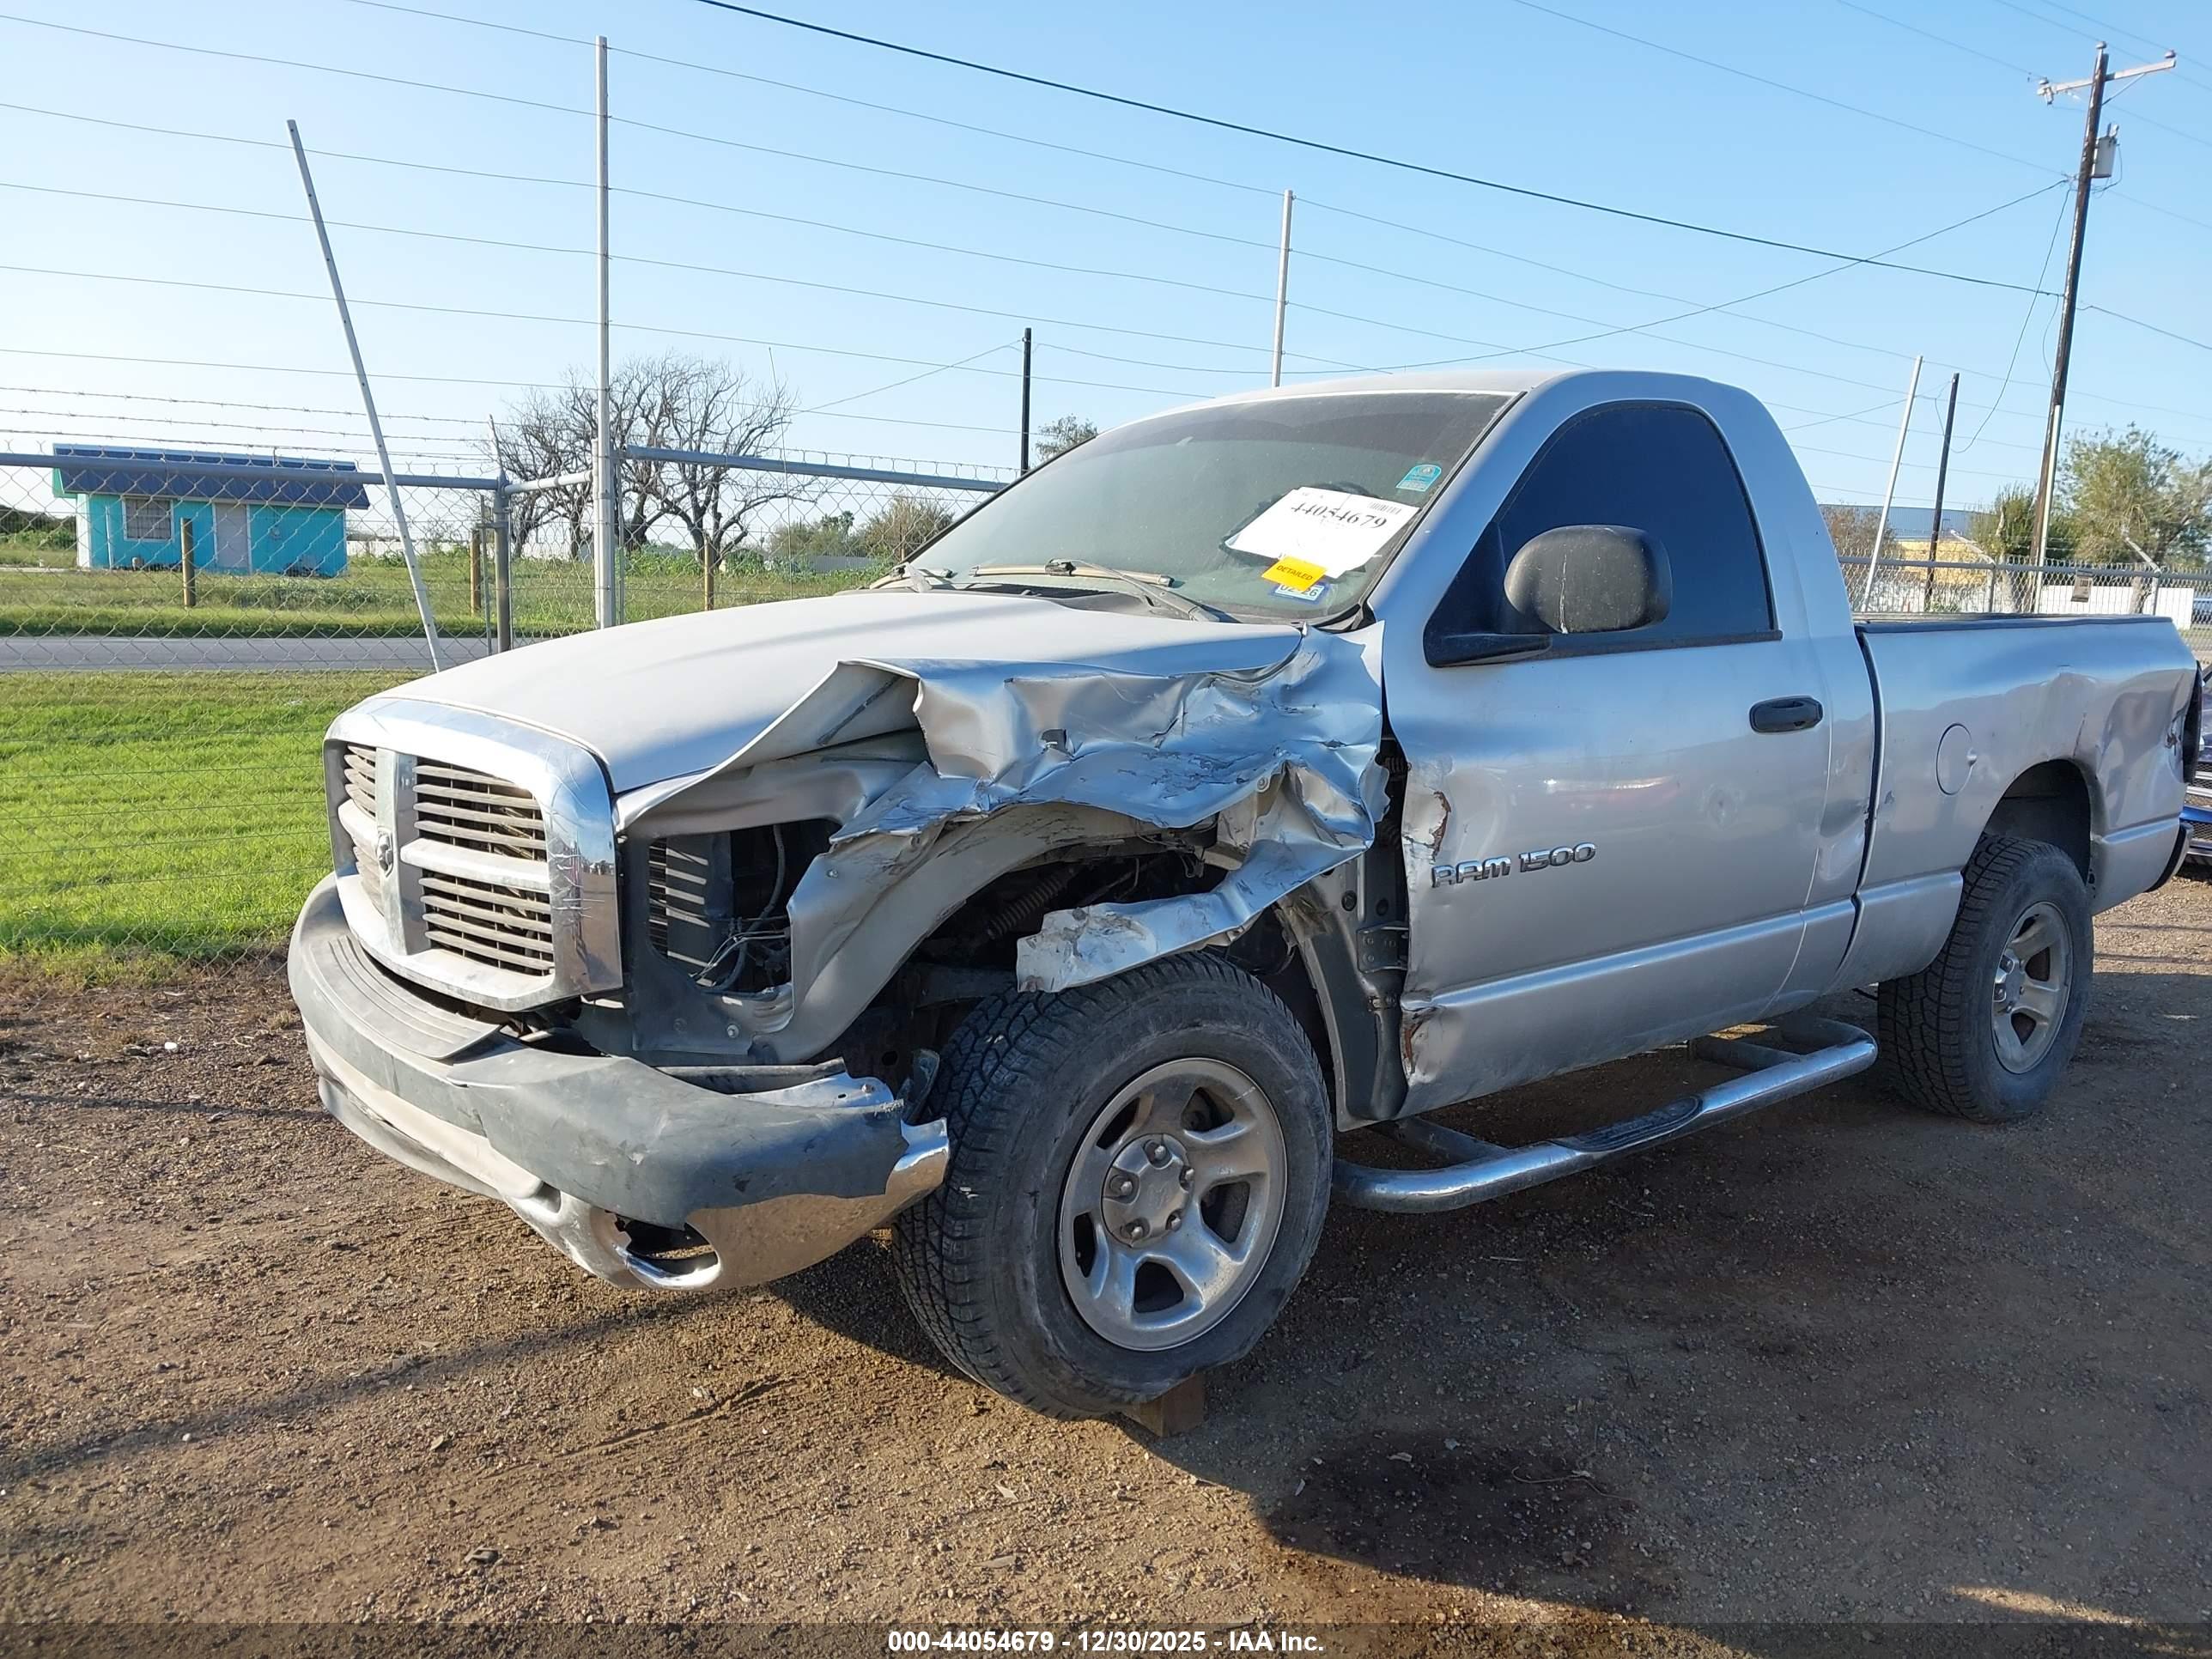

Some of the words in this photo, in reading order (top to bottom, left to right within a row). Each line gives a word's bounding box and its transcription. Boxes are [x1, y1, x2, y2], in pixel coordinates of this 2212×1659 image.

[1291, 502, 1388, 529] 44054679
[1276, 565, 1313, 581] DETAILED
[1431, 856, 1511, 888] RAM
[1518, 842, 1596, 873] 1500
